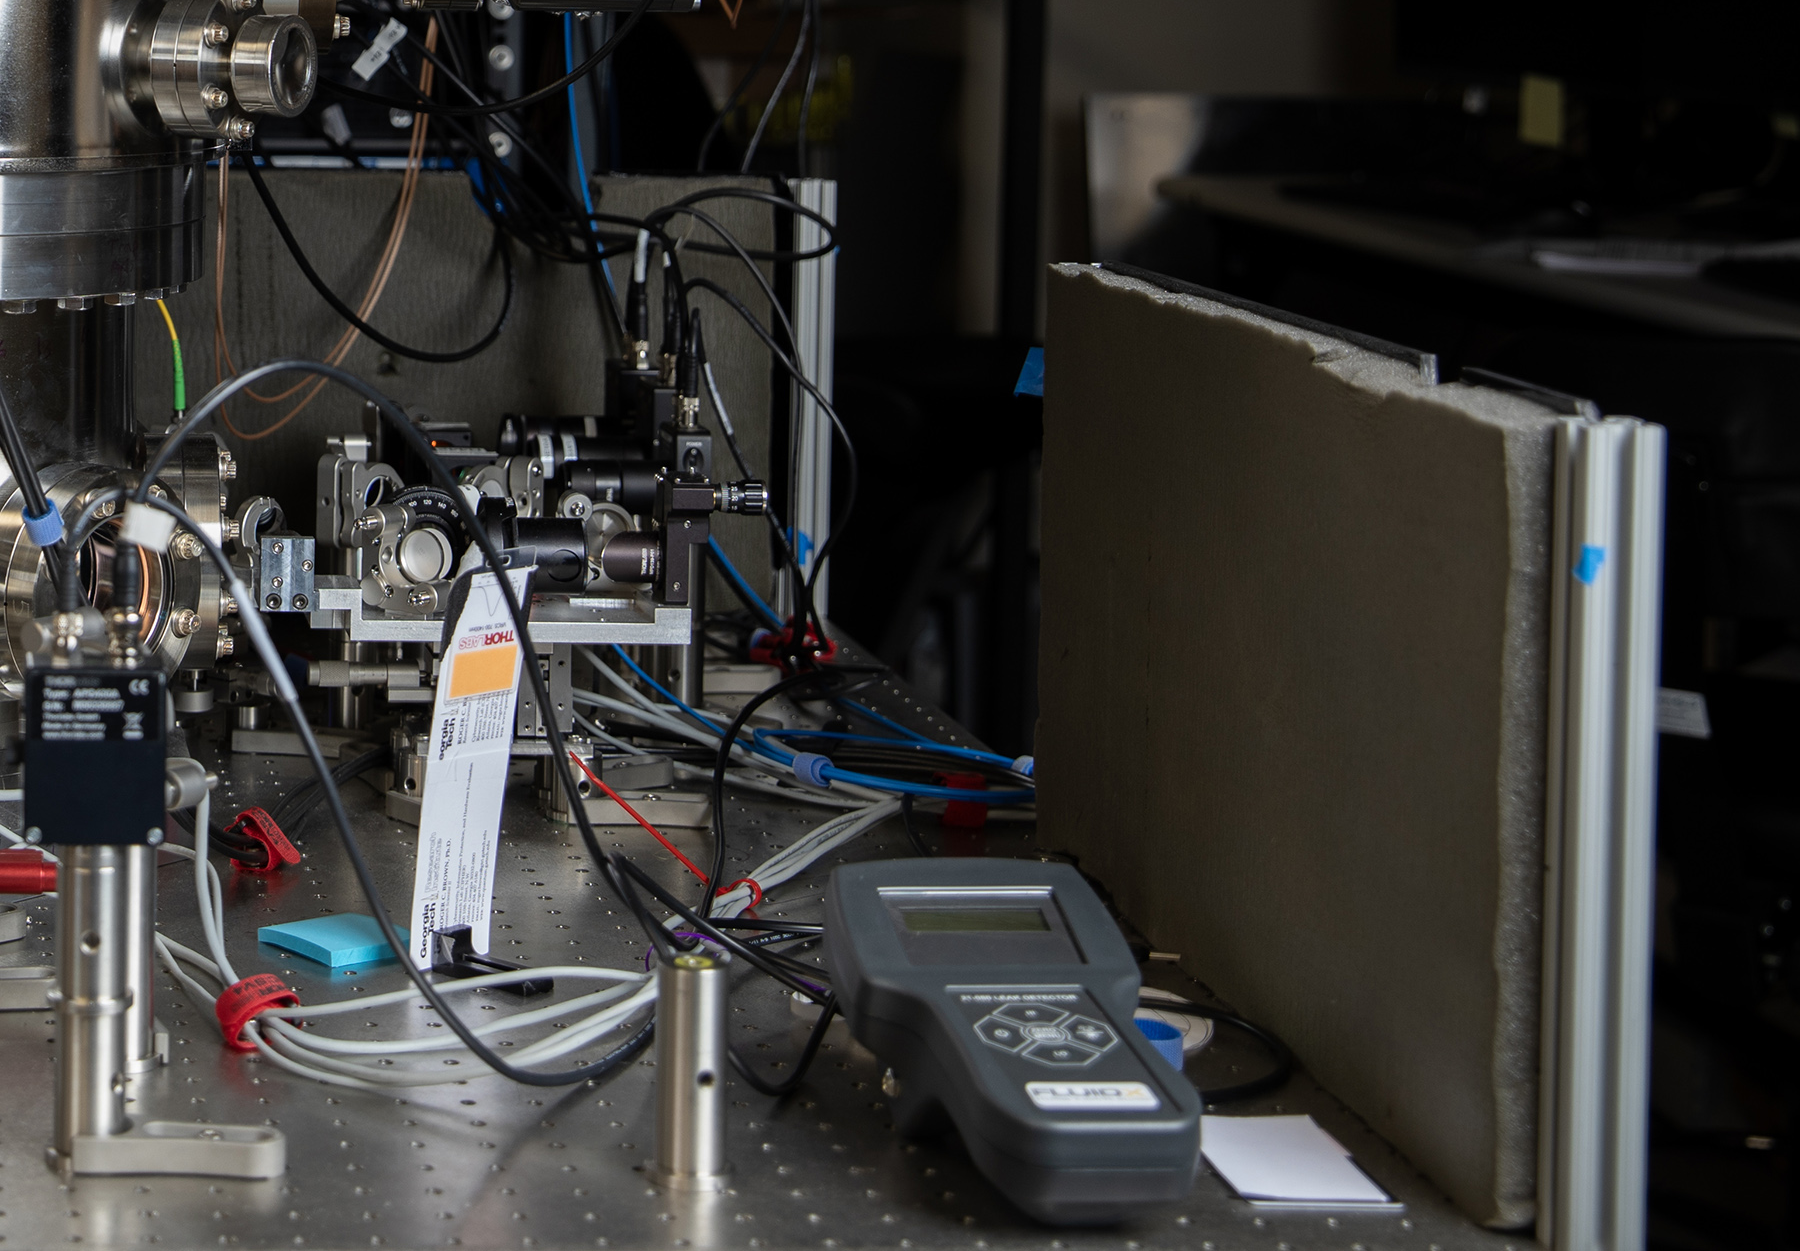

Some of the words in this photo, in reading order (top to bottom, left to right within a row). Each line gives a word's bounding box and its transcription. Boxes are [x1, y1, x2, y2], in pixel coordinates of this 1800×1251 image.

[422, 498, 432, 506] 120
[437, 501, 447, 510] 140
[458, 630, 515, 649] THORLABS
[438, 718, 449, 761] eorgia
[445, 717, 456, 750] Tech
[457, 716, 466, 745] ROGER
[425, 832, 437, 893] Research
[431, 838, 442, 892] Institute
[442, 859, 450, 891] BROWN,
[441, 892, 447, 900] C.
[420, 903, 430, 959] Georgia
[427, 902, 436, 937] Tech
[1022, 994, 1078, 1002] DETECTOR
